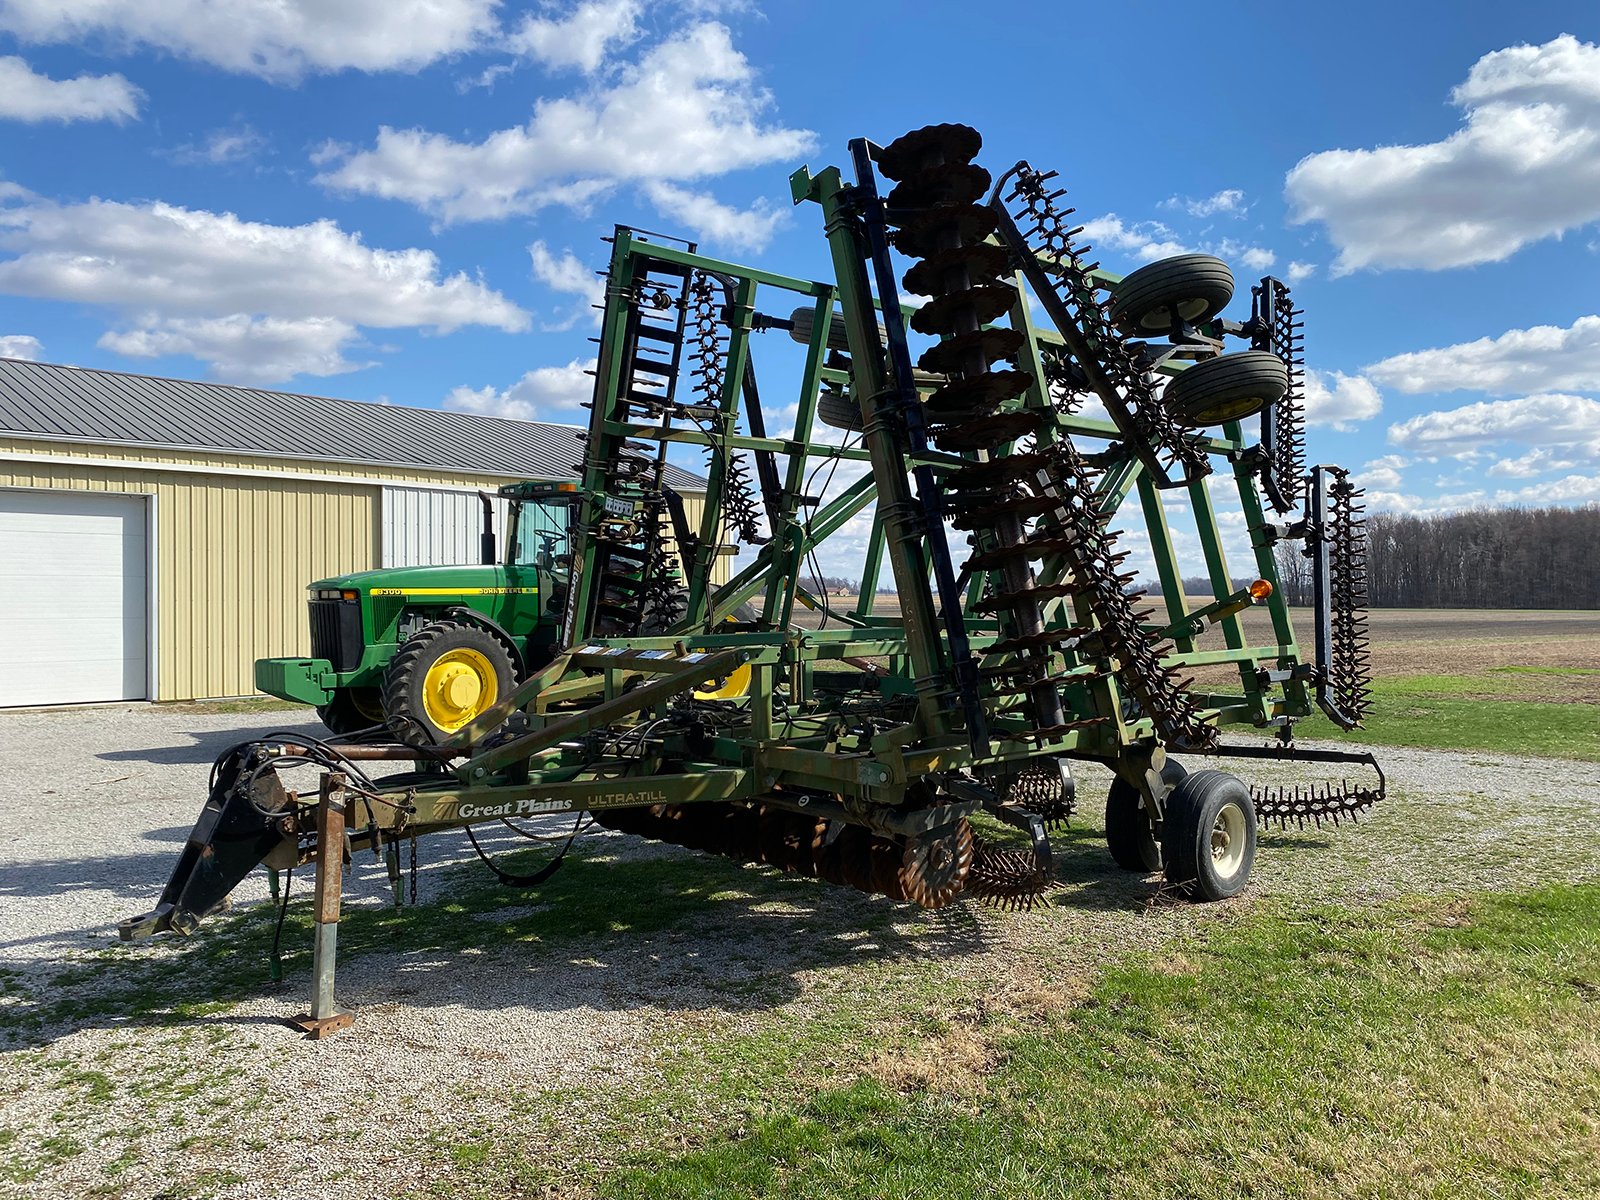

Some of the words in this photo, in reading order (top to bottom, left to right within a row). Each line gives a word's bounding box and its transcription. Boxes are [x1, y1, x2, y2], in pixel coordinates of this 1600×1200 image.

[587, 790, 667, 806] ULTRA-TILL
[458, 802, 512, 818] Great
[515, 797, 573, 814] Plains
